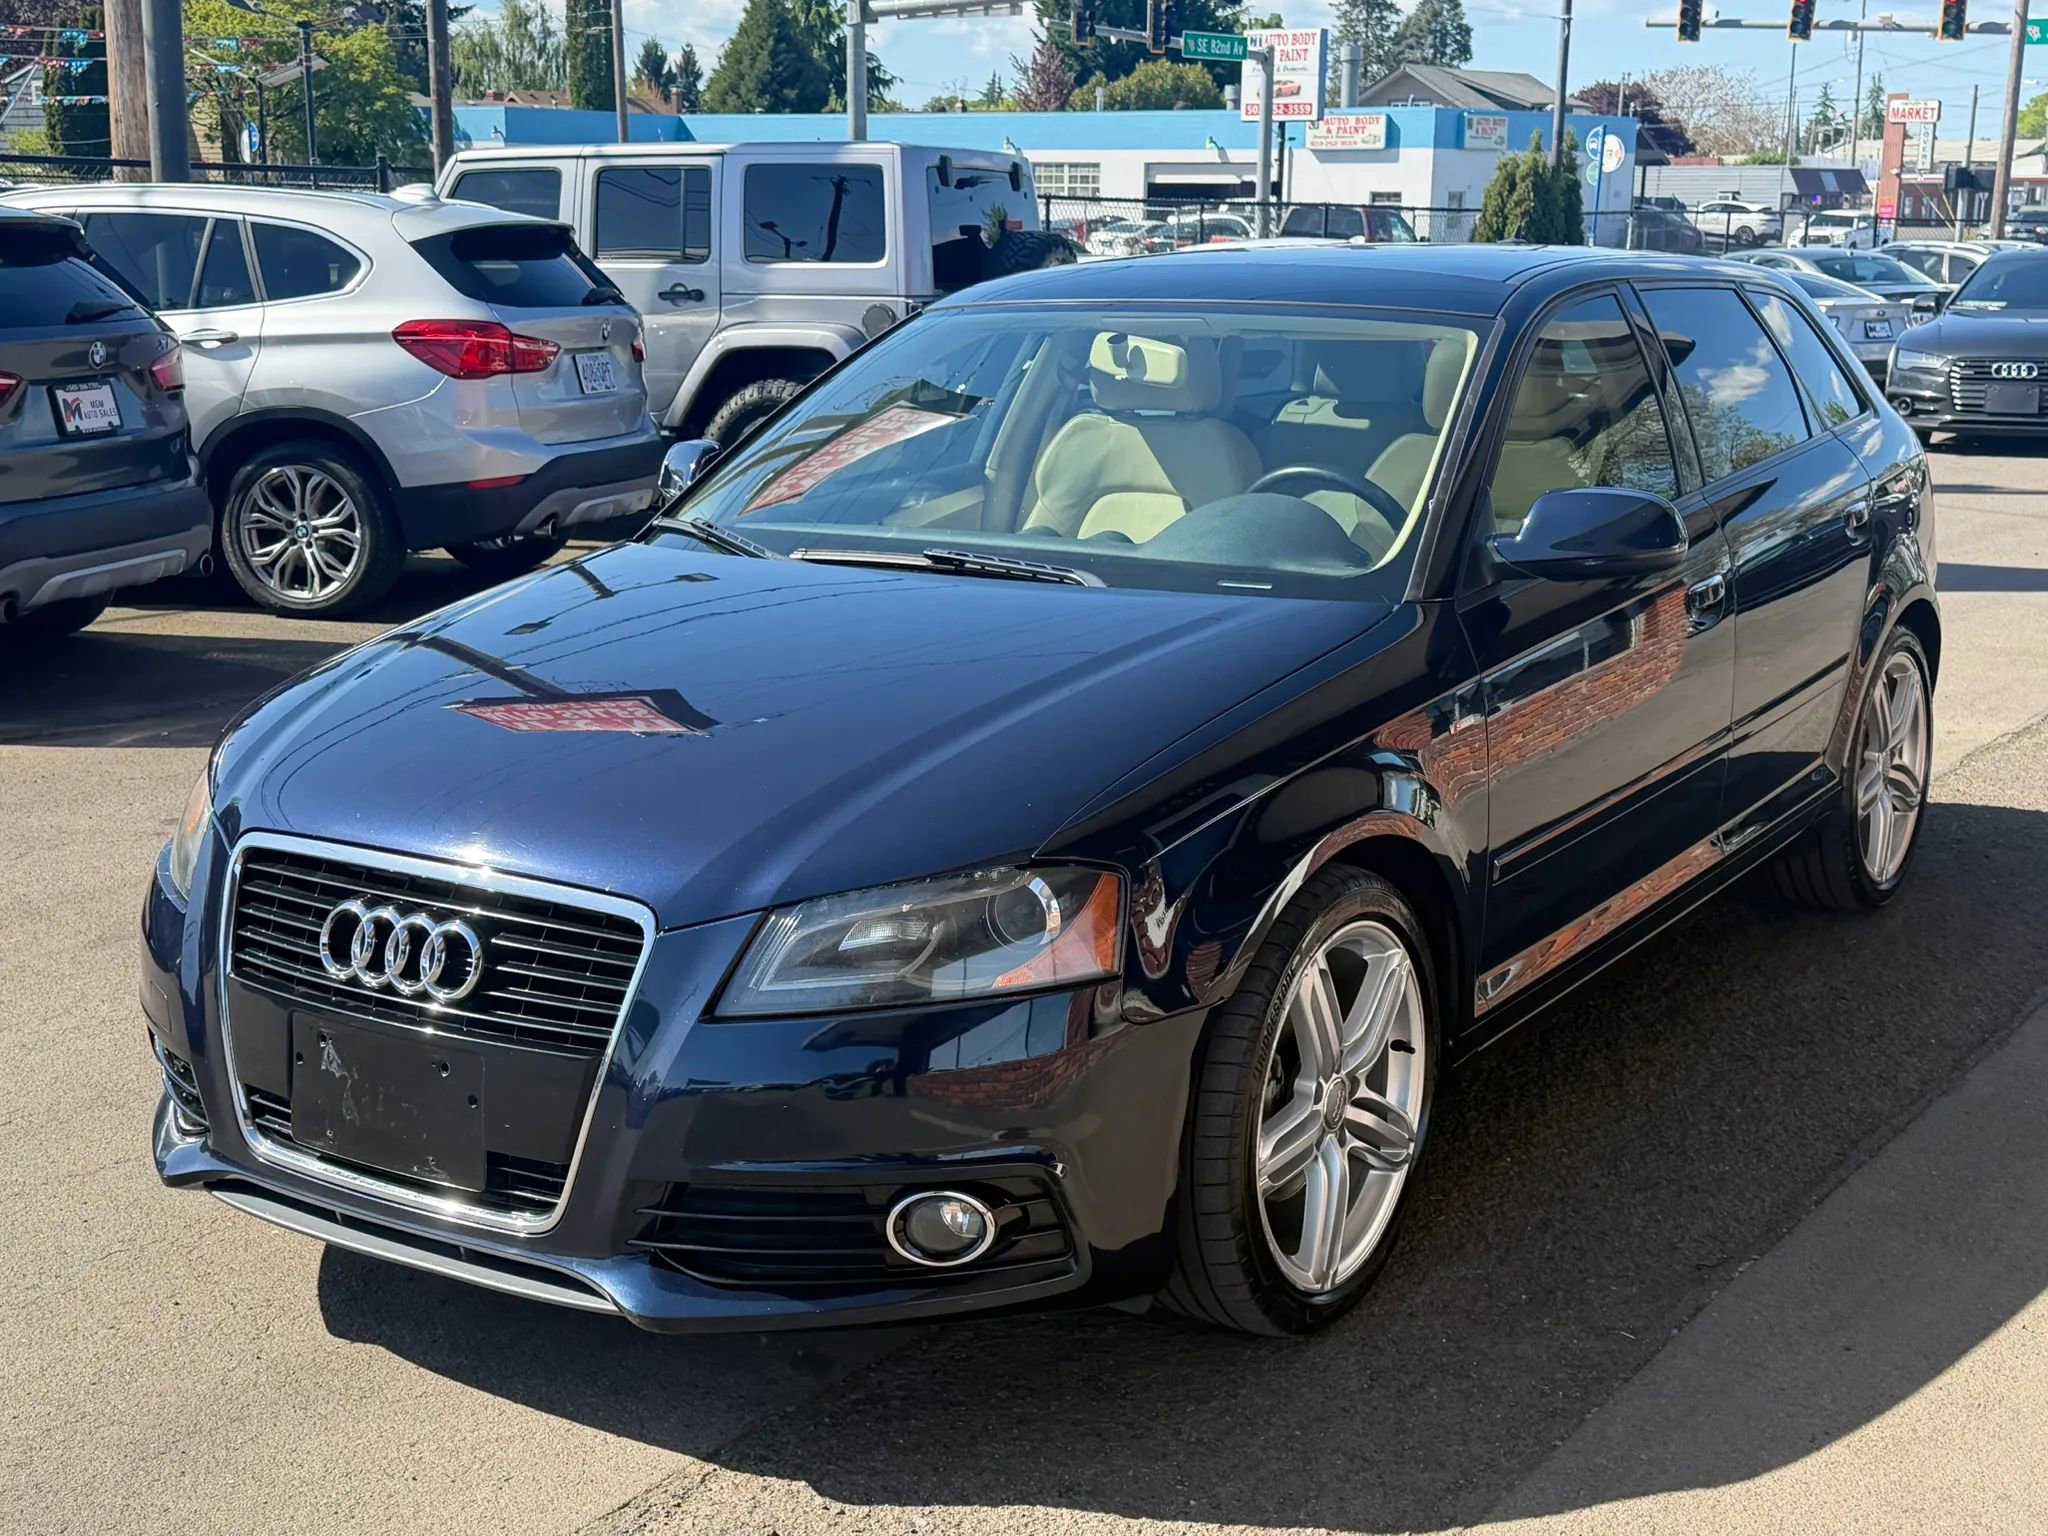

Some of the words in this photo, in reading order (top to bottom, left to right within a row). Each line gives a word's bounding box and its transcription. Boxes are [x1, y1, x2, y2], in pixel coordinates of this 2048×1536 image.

[1264, 33, 1289, 46] AUTO
[1291, 32, 1317, 46] BODY
[1196, 37, 1208, 53] SE
[1210, 39, 1231, 55] 82nd
[1233, 41, 1244, 56] Av
[1280, 48, 1309, 62] PAINT
[1891, 106, 1936, 120] MARKET
[1323, 116, 1350, 126] AUTO
[1355, 116, 1381, 125] BODY
[1326, 127, 1332, 135] &
[1336, 126, 1367, 135] PAINT
[83, 410, 98, 419] AUTO
[98, 407, 118, 418] SALES
